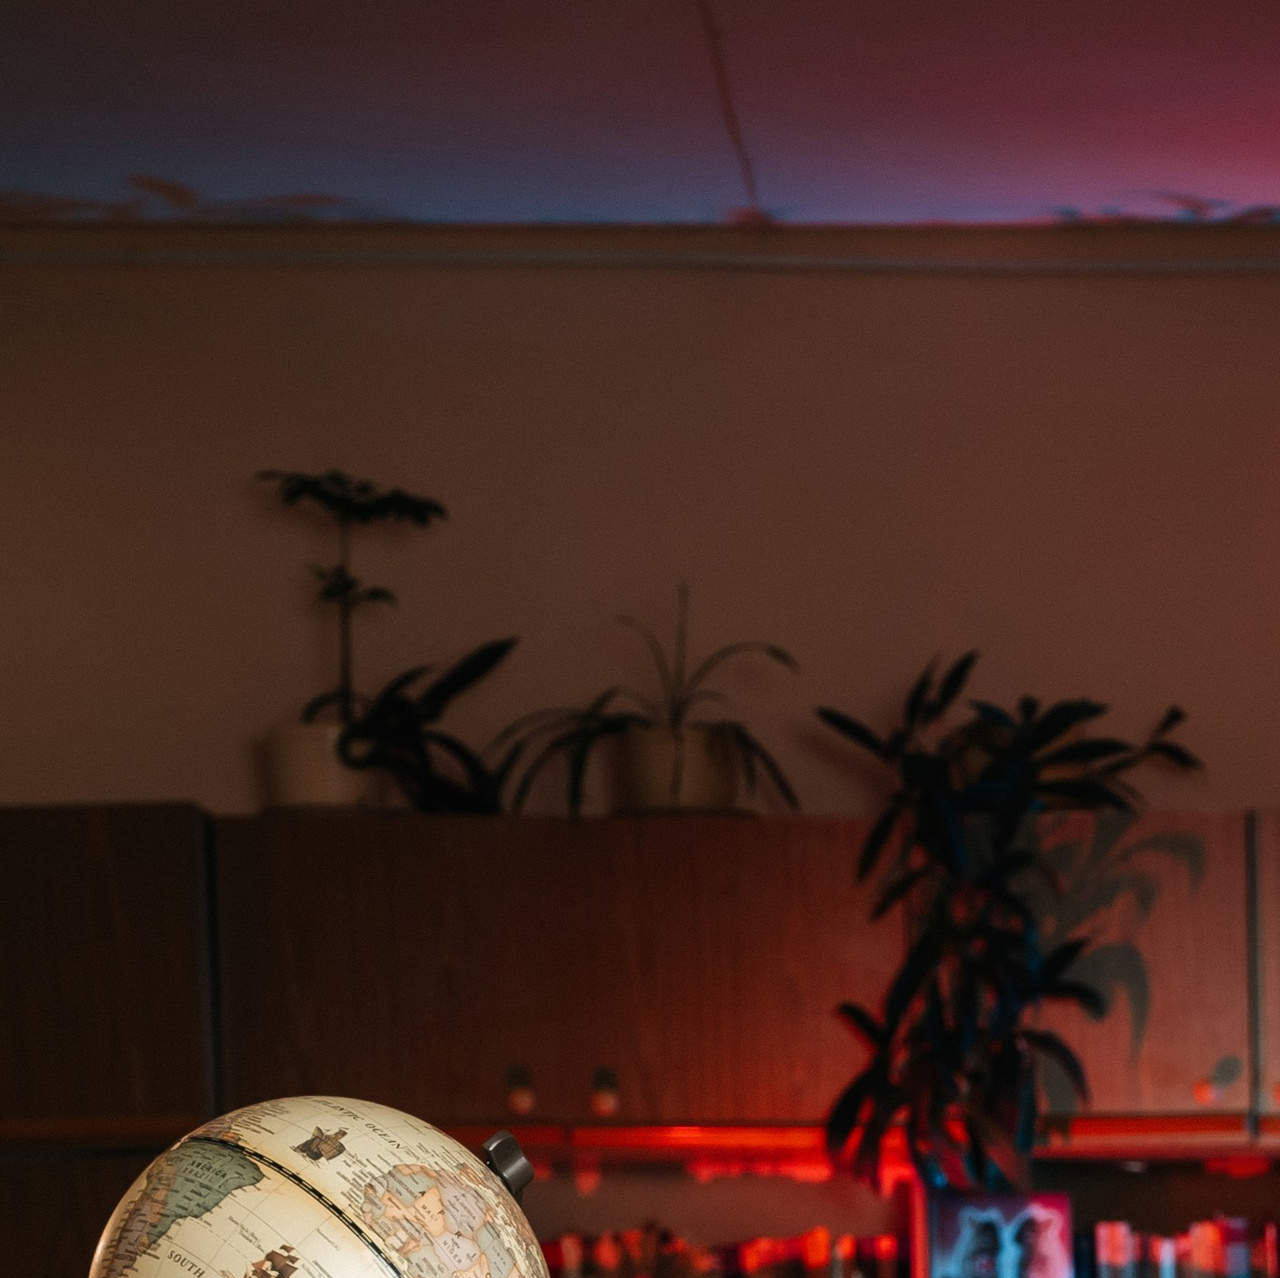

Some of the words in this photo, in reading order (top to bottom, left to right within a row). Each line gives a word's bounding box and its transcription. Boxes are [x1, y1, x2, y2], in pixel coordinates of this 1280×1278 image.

[364, 1121, 402, 1150] OCEAN
[421, 1203, 438, 1222] MALI
[168, 1249, 204, 1278] SOUTH
[441, 1239, 462, 1264] NIGER
